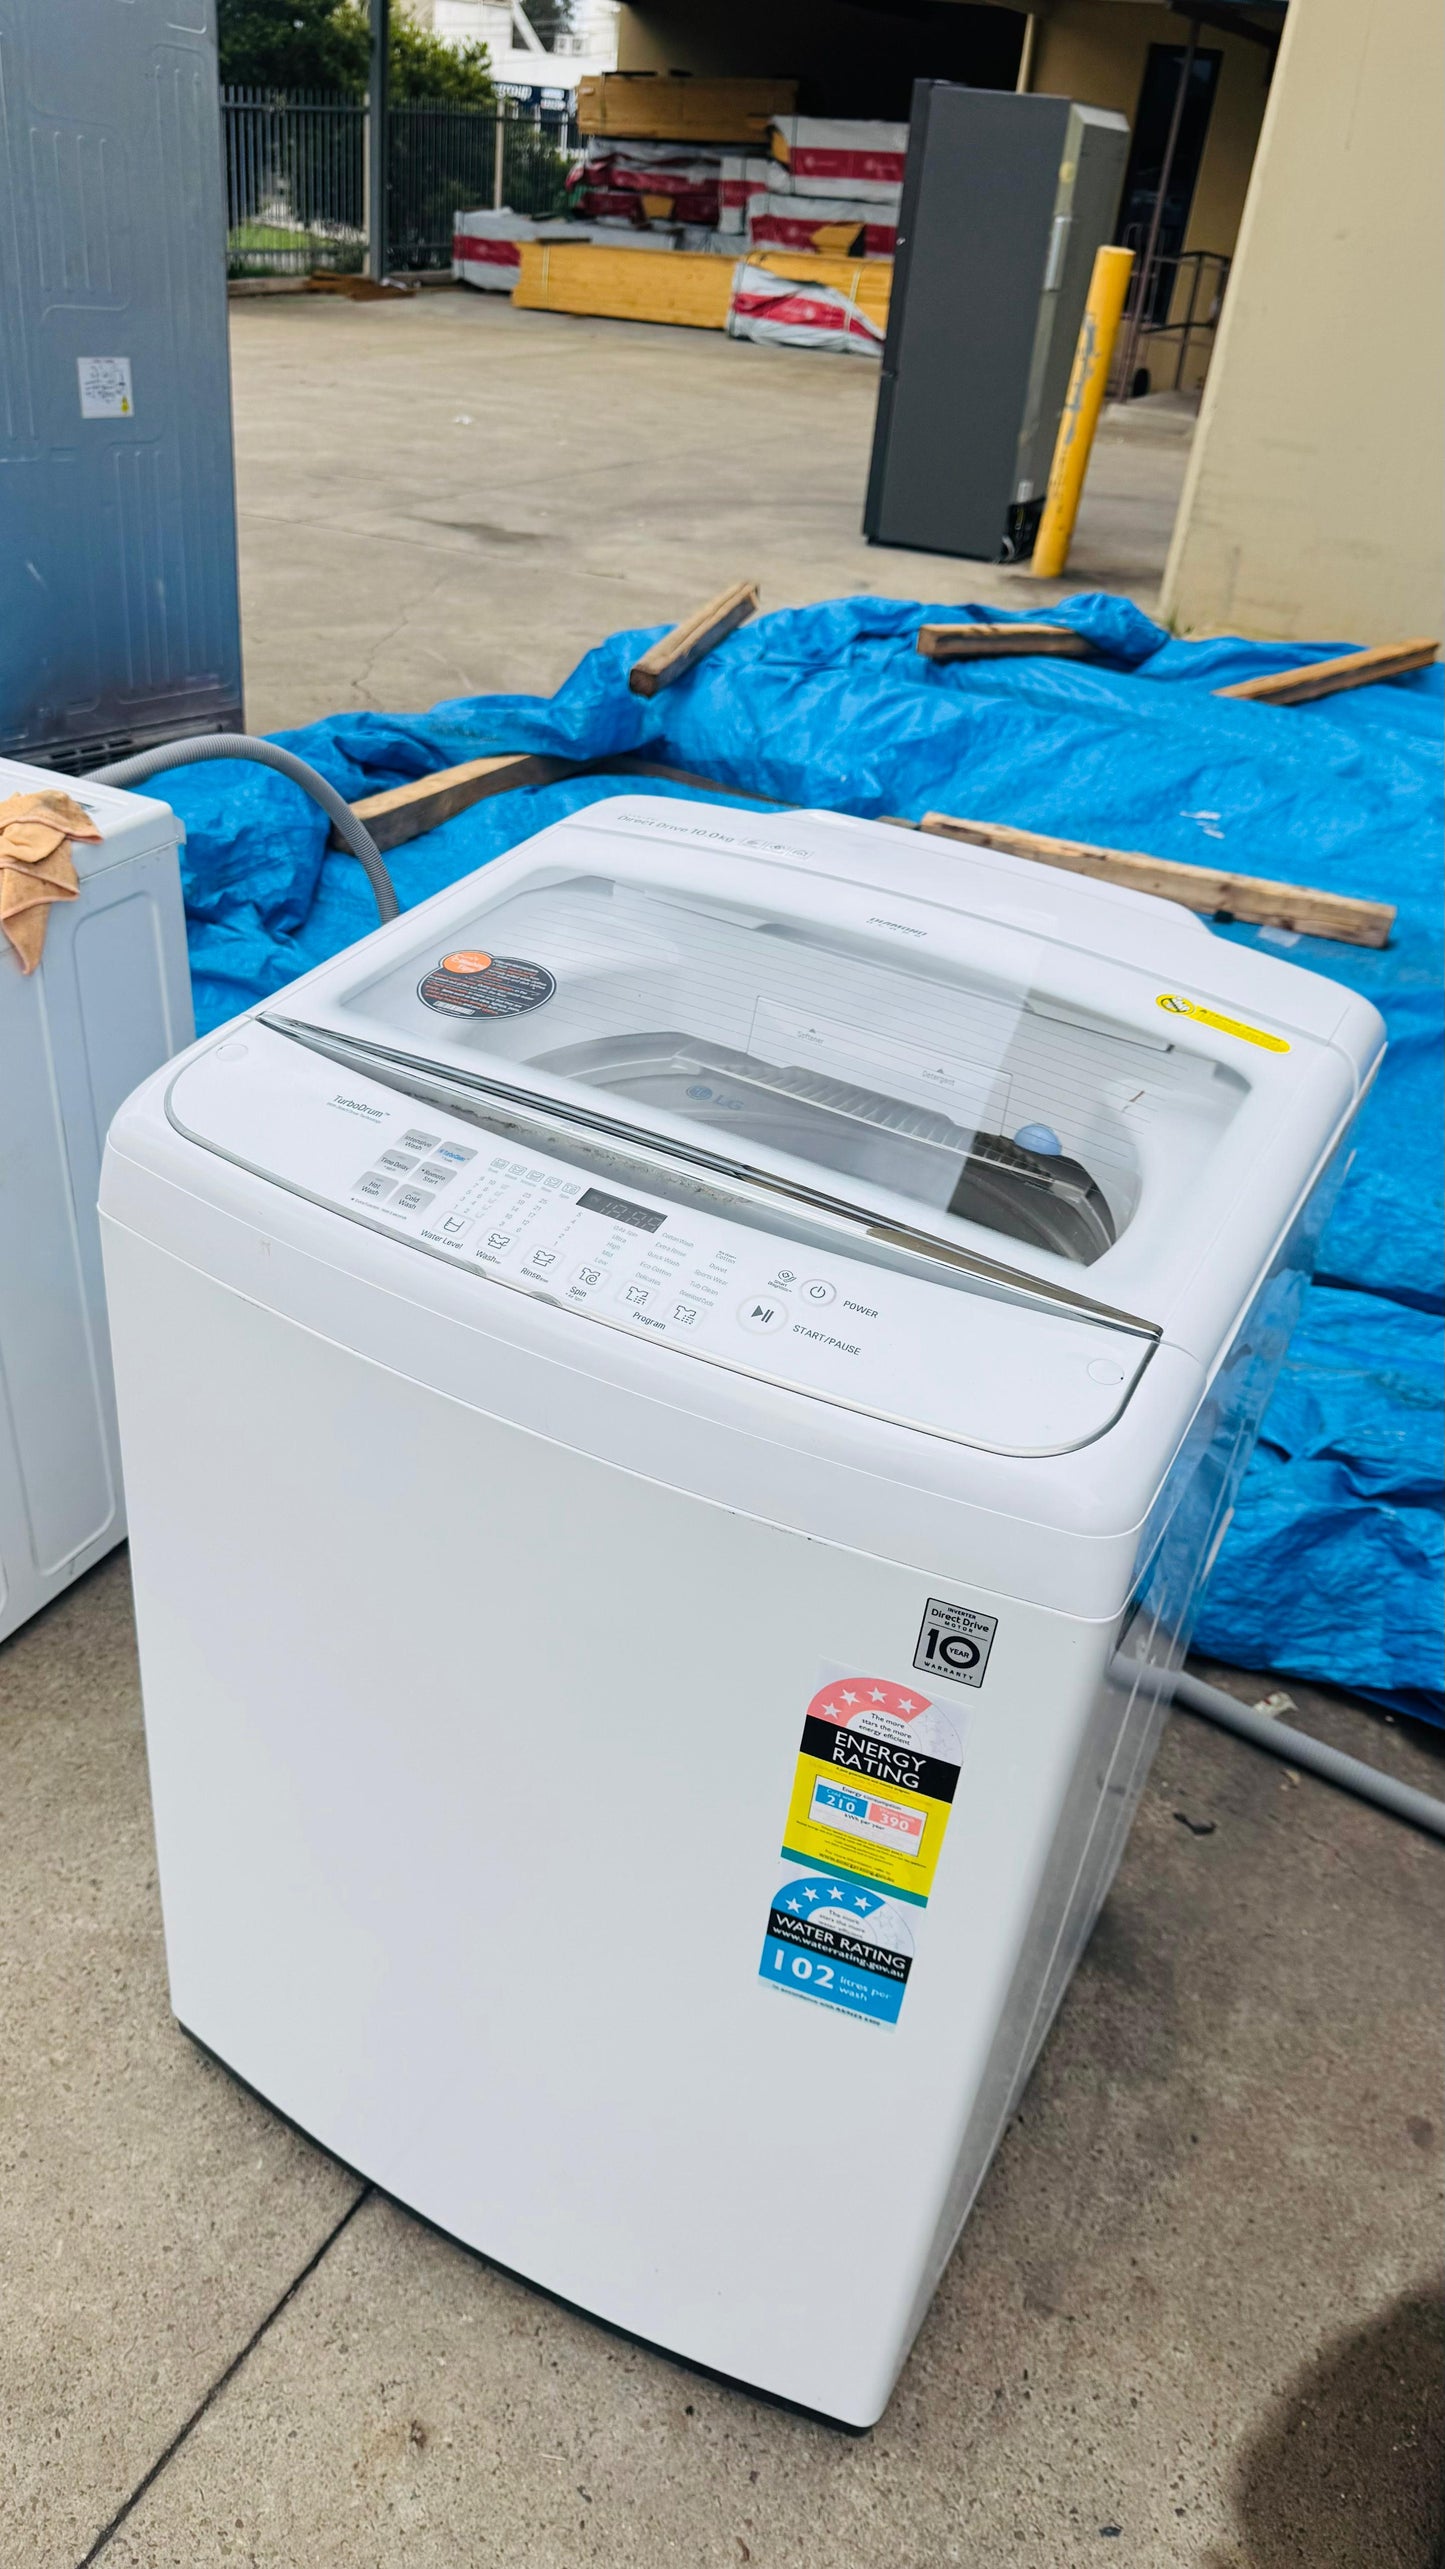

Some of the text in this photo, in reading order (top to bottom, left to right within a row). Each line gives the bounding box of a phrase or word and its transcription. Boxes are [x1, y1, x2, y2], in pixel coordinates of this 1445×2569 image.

[616, 814, 654, 827] Direct
[655, 821, 689, 833] Drive
[404, 1141, 423, 1151] Wash
[361, 1185, 380, 1196] Wash
[369, 1181, 381, 1190] Hot
[398, 1200, 418, 1211] Wash
[420, 1229, 464, 1250] Water Level
[475, 1249, 496, 1263] Wash
[520, 1267, 541, 1280] Rinse
[569, 1286, 587, 1299] Spin
[843, 1300, 879, 1319] POWER
[632, 1311, 667, 1331] Program
[792, 1324, 862, 1356] START/PAUSE
[931, 1608, 990, 1633] Direct Drive
[947, 1607, 977, 1620] INVERTER
[944, 1621, 974, 1634] MOTOR
[925, 1628, 981, 1669] 10
[949, 1646, 970, 1659] YEAR
[923, 1660, 974, 1681] WARRANTY
[862, 1719, 912, 1739] stars the more
[871, 1712, 905, 1729] The more
[858, 1725, 910, 1746] energy efficient
[835, 1730, 927, 1773] ENERGY
[831, 1747, 921, 1789] RATING
[842, 1786, 863, 1798] Energy
[826, 1794, 856, 1813] 210
[880, 1812, 910, 1832] 390
[776, 1913, 906, 1970] WATER RATING
[772, 1926, 904, 1979] www.waterrating.gov.au
[774, 1948, 836, 1990] 102
[839, 1986, 868, 2002] wash
[840, 1976, 892, 2001] litres per
